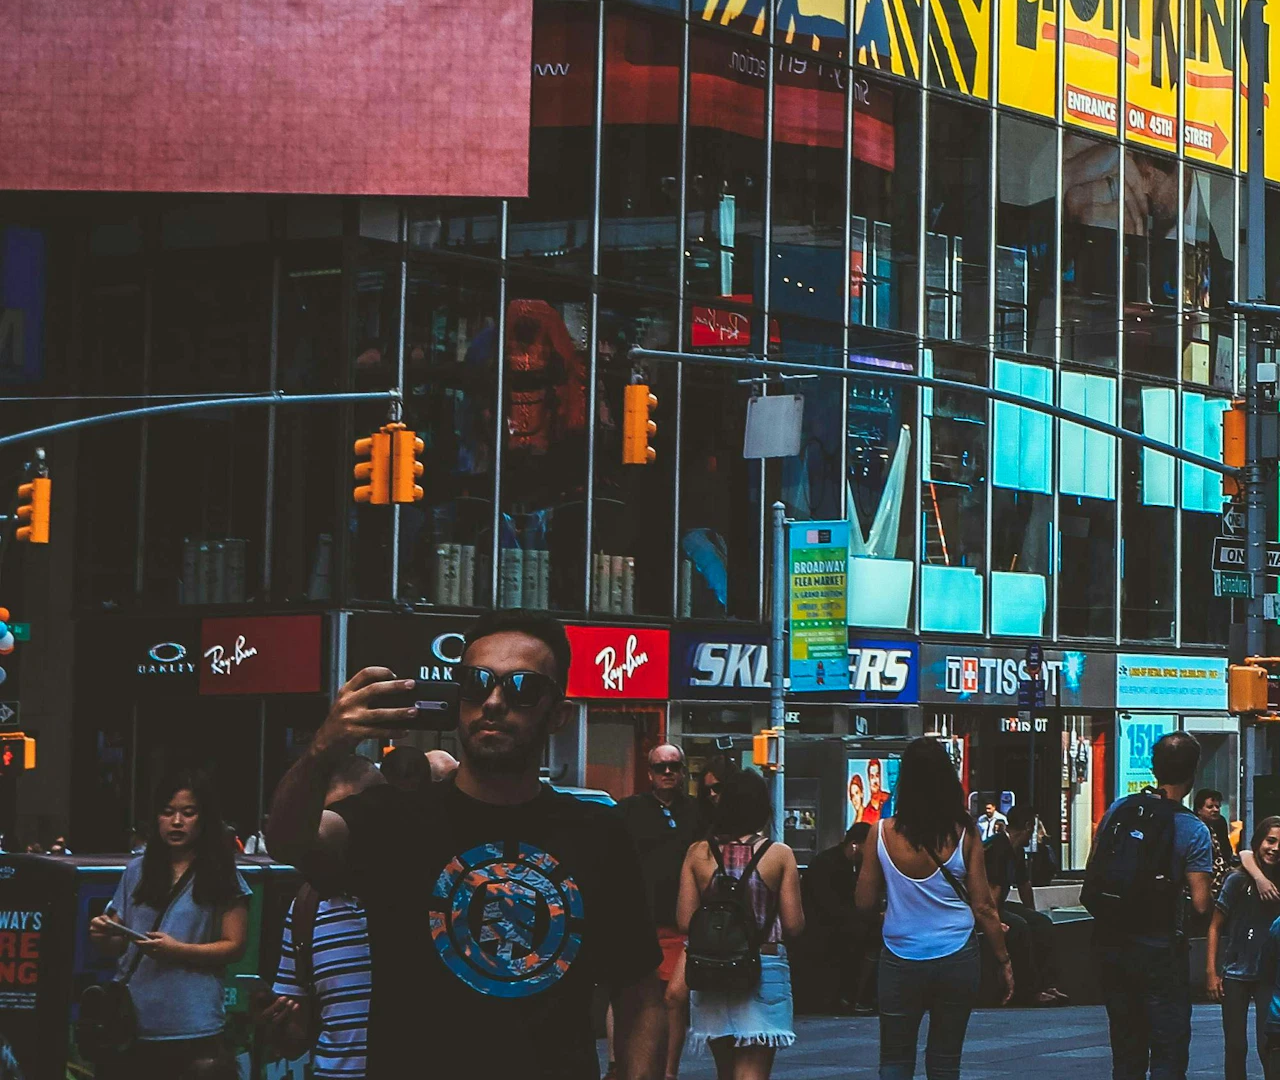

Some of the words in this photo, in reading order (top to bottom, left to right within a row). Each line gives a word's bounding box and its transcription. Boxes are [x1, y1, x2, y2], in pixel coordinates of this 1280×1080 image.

[1067, 89, 1116, 122] ENTRANCE
[1128, 107, 1145, 129] ON
[1148, 111, 1173, 138] 45TH
[1185, 125, 1214, 151] STREET
[1227, 549, 1245, 562] ON
[793, 561, 846, 574] BROADWAY
[794, 575, 813, 587] FLEA
[814, 575, 845, 587] MARKET
[203, 635, 258, 675] Ray-Ban
[137, 661, 196, 675] OAKLEY
[595, 634, 648, 691] Ray-Ban
[694, 641, 912, 694] SKERS
[420, 666, 453, 680] OAK
